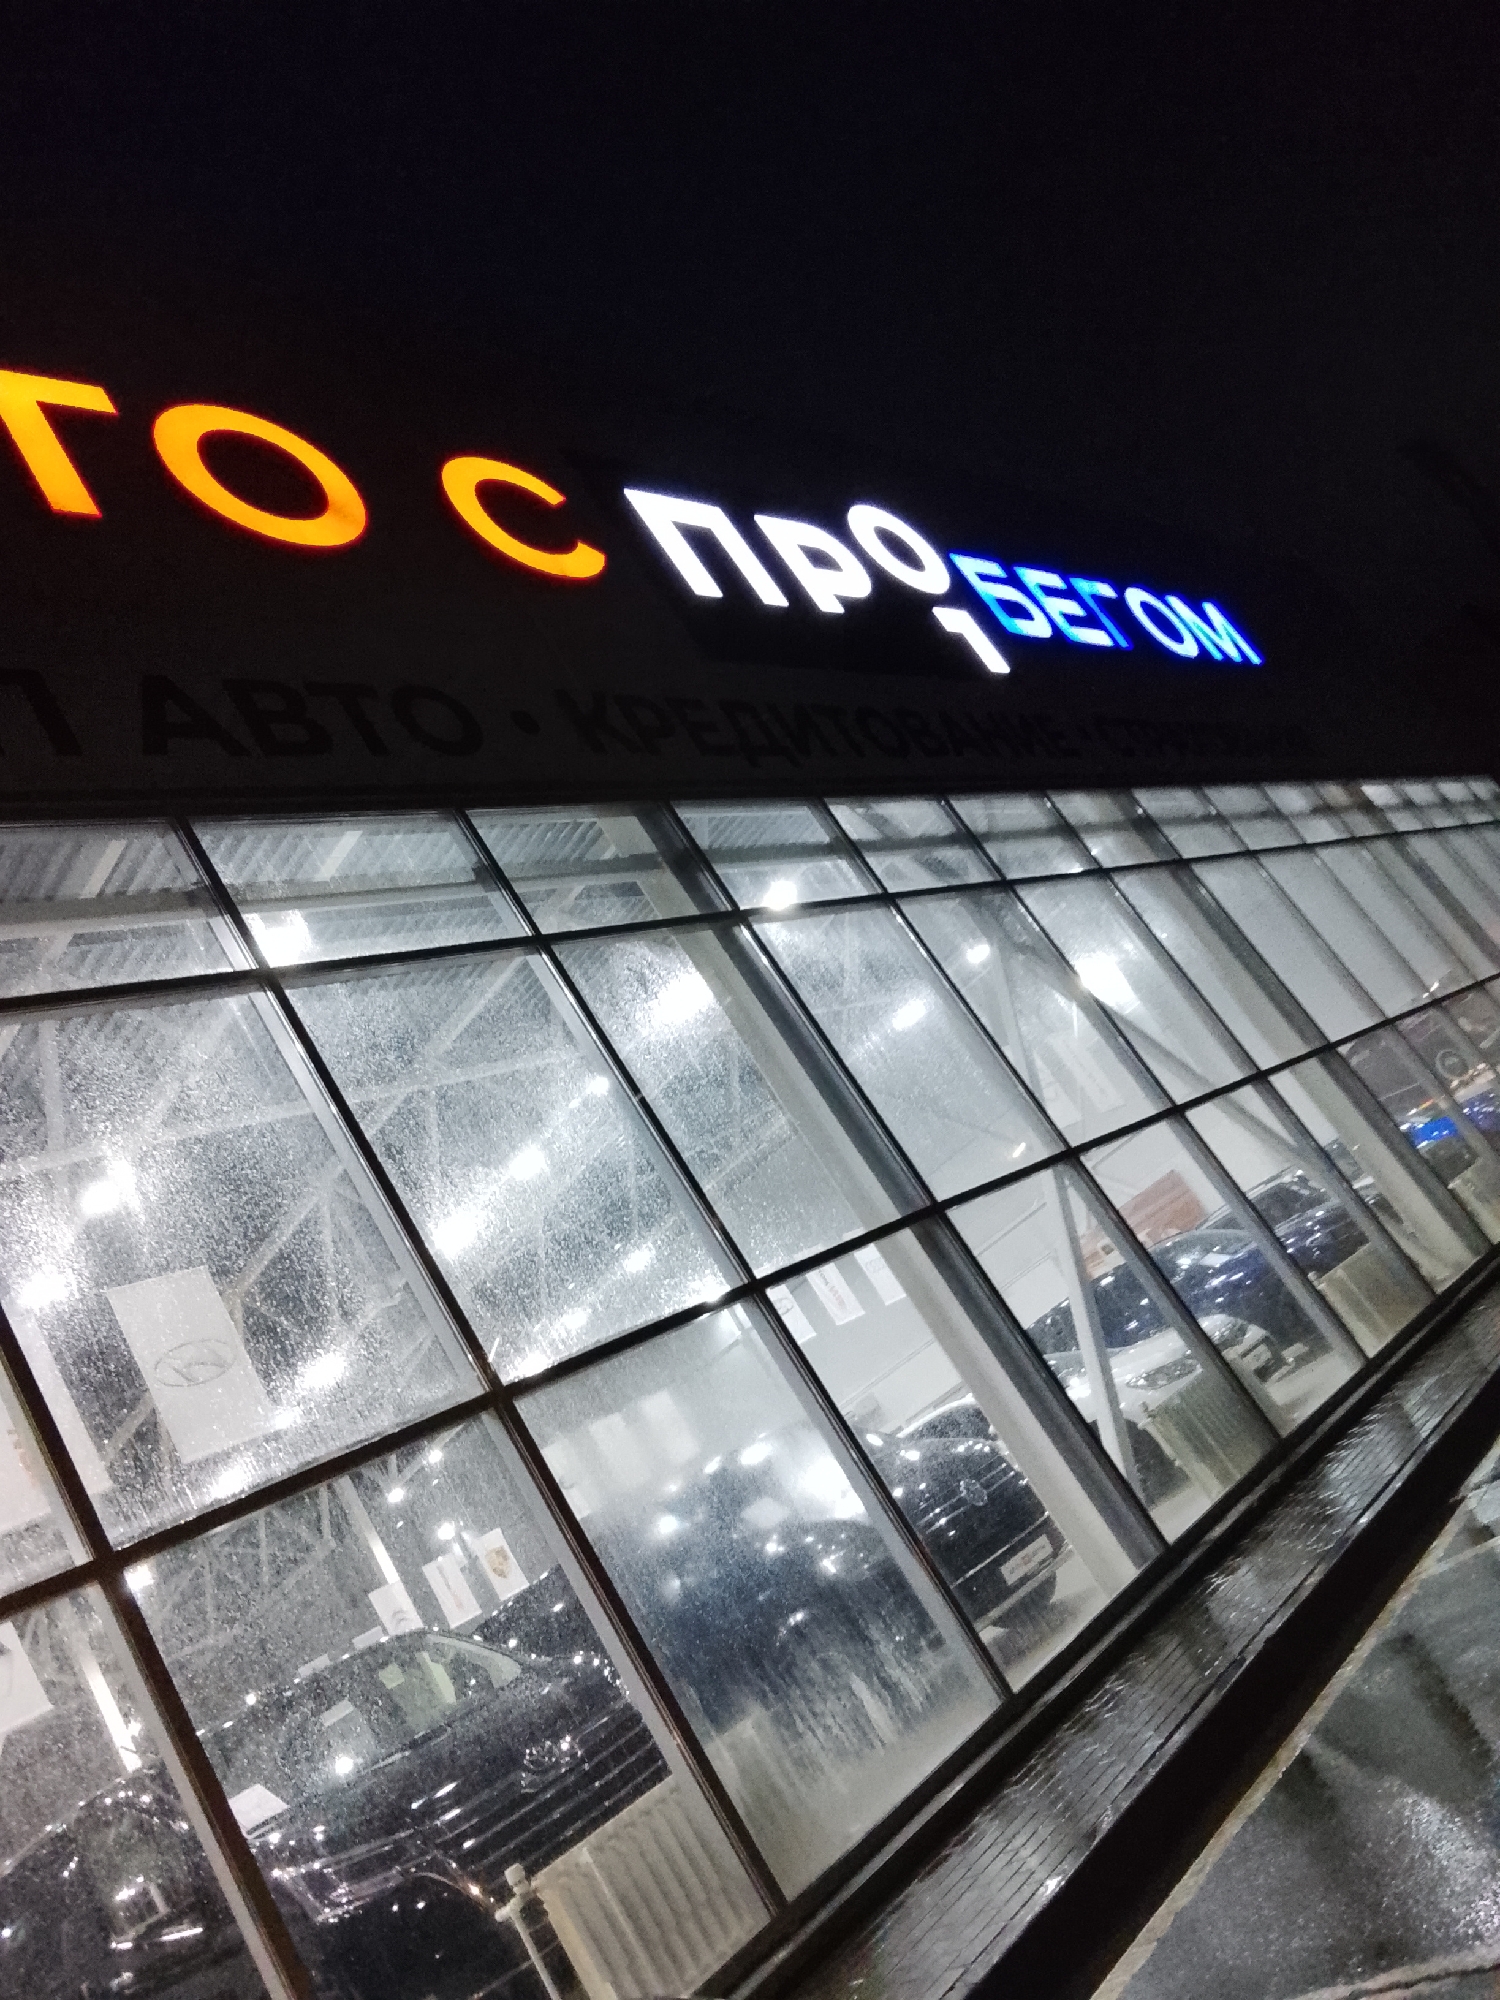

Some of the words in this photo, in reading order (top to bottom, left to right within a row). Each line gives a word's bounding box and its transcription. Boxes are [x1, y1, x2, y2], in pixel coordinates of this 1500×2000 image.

[440, 455, 607, 581] С
[931, 604, 1011, 675] 1
[141, 674, 484, 757] АВТО
